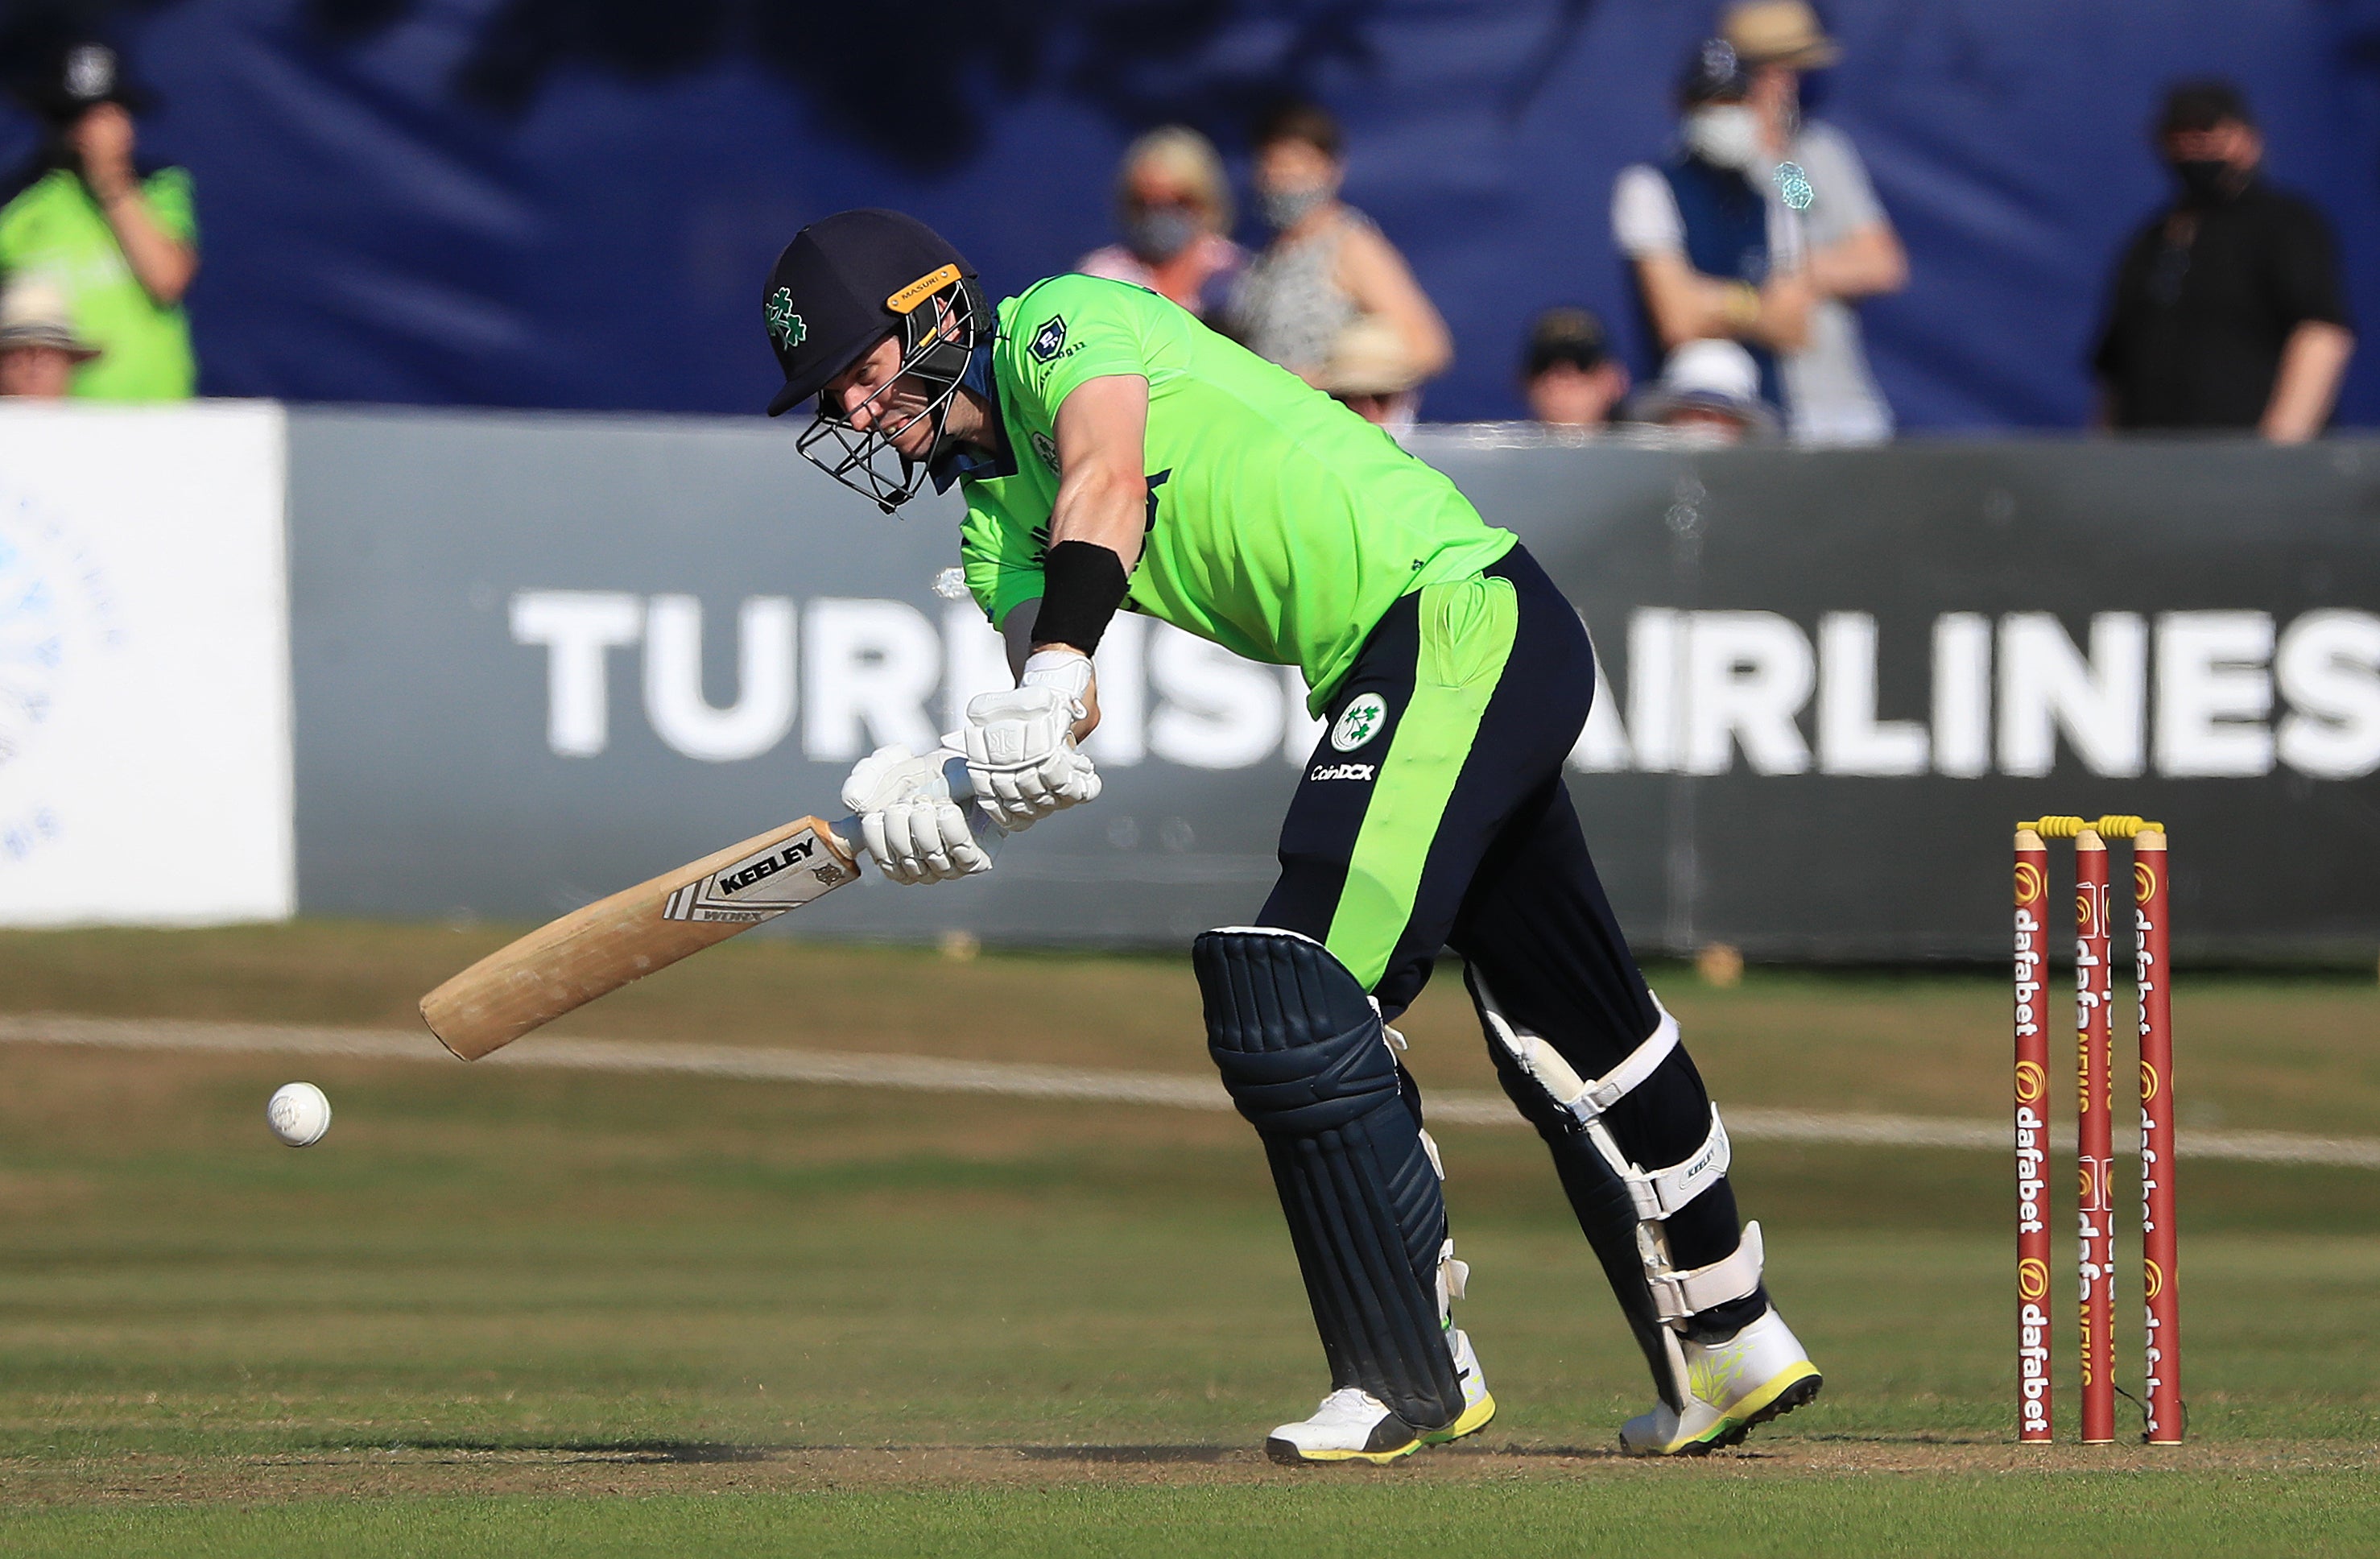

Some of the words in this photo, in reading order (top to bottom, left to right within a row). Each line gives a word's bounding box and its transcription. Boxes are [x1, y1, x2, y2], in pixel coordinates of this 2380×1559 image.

[902, 276, 939, 300] MASURI
[1311, 763, 1375, 781] CoinDCX
[719, 837, 814, 895] KEELEY
[703, 910, 763, 922] WORX
[2014, 908, 2040, 1037] dafabet
[2016, 1106, 2045, 1234] dafabet
[2019, 1303, 2049, 1432] dafabet
